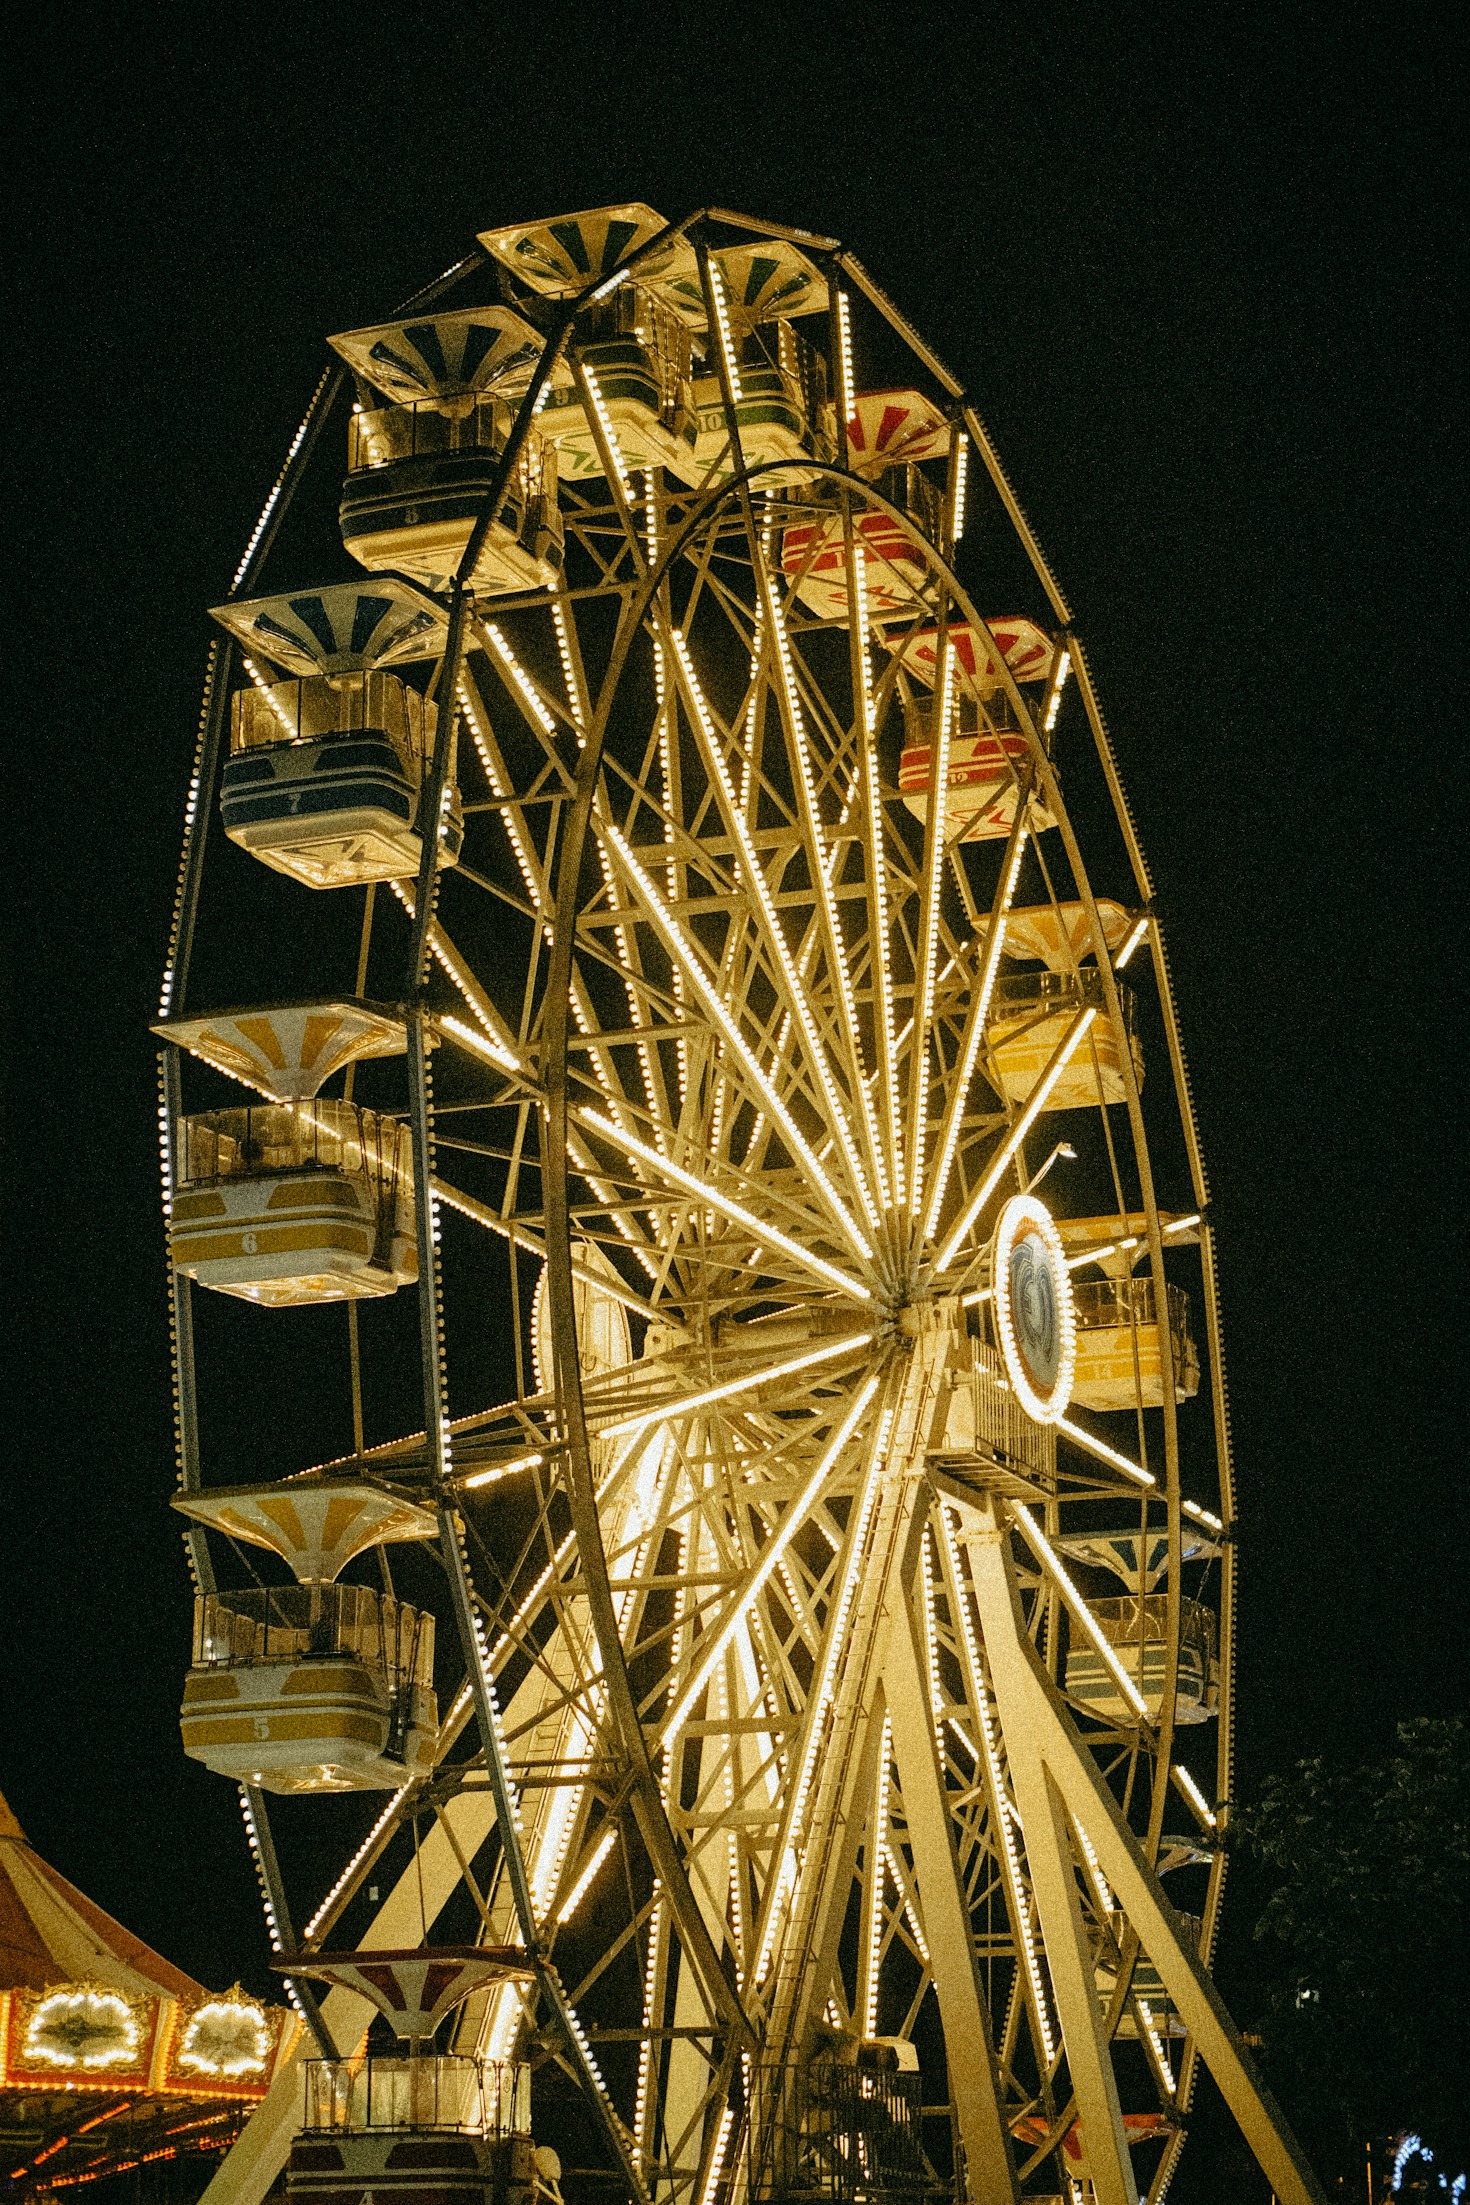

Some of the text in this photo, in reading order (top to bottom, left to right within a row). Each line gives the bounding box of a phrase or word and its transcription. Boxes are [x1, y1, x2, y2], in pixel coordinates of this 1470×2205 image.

[554, 388, 569, 405] 9
[699, 414, 722, 431] 10
[289, 793, 301, 813] 7
[241, 1233, 258, 1253] 6
[254, 1716, 270, 1740] 5
